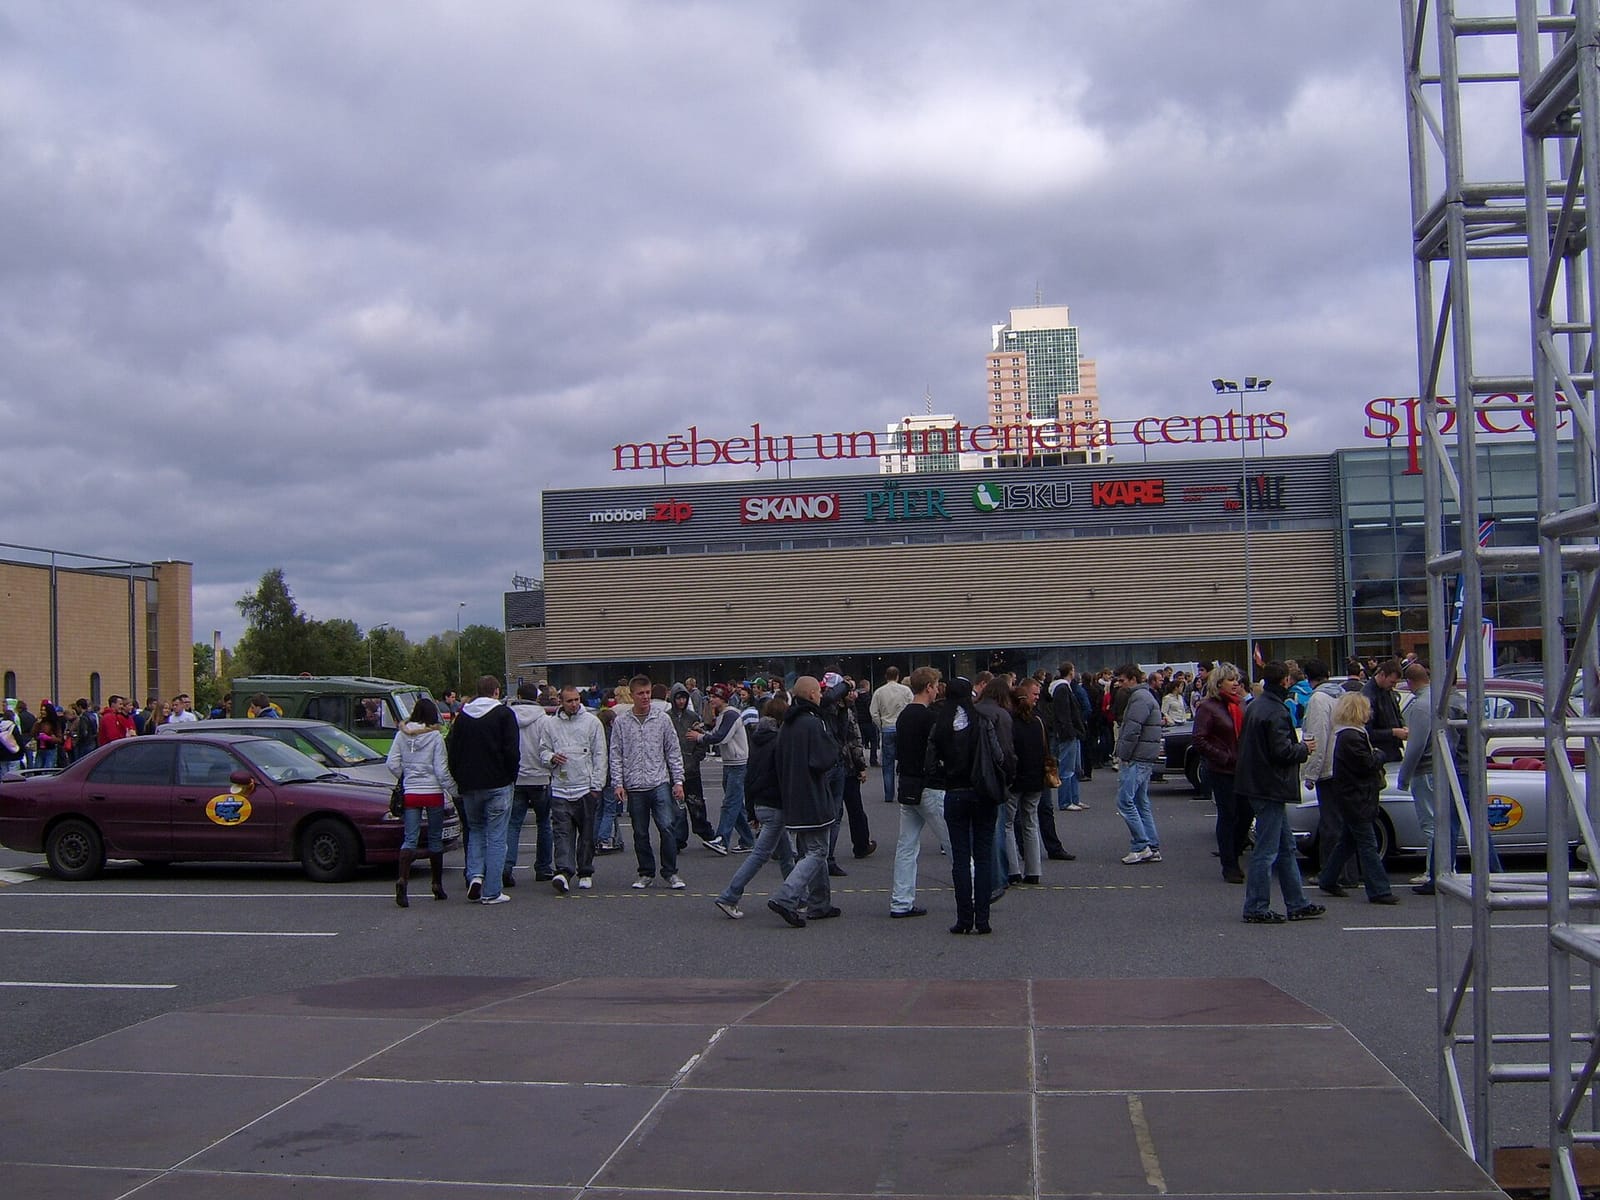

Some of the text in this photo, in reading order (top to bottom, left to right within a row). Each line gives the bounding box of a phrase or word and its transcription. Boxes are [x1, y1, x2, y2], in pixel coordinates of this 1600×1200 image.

[813, 431, 878, 460] un
[903, 411, 1115, 467] interjera
[1133, 408, 1288, 444] centrs
[1363, 391, 1568, 476] spce
[745, 495, 834, 521] SKANO
[864, 488, 953, 522] PIER
[1002, 481, 1073, 510] ISKU
[1092, 480, 1165, 506] KARE
